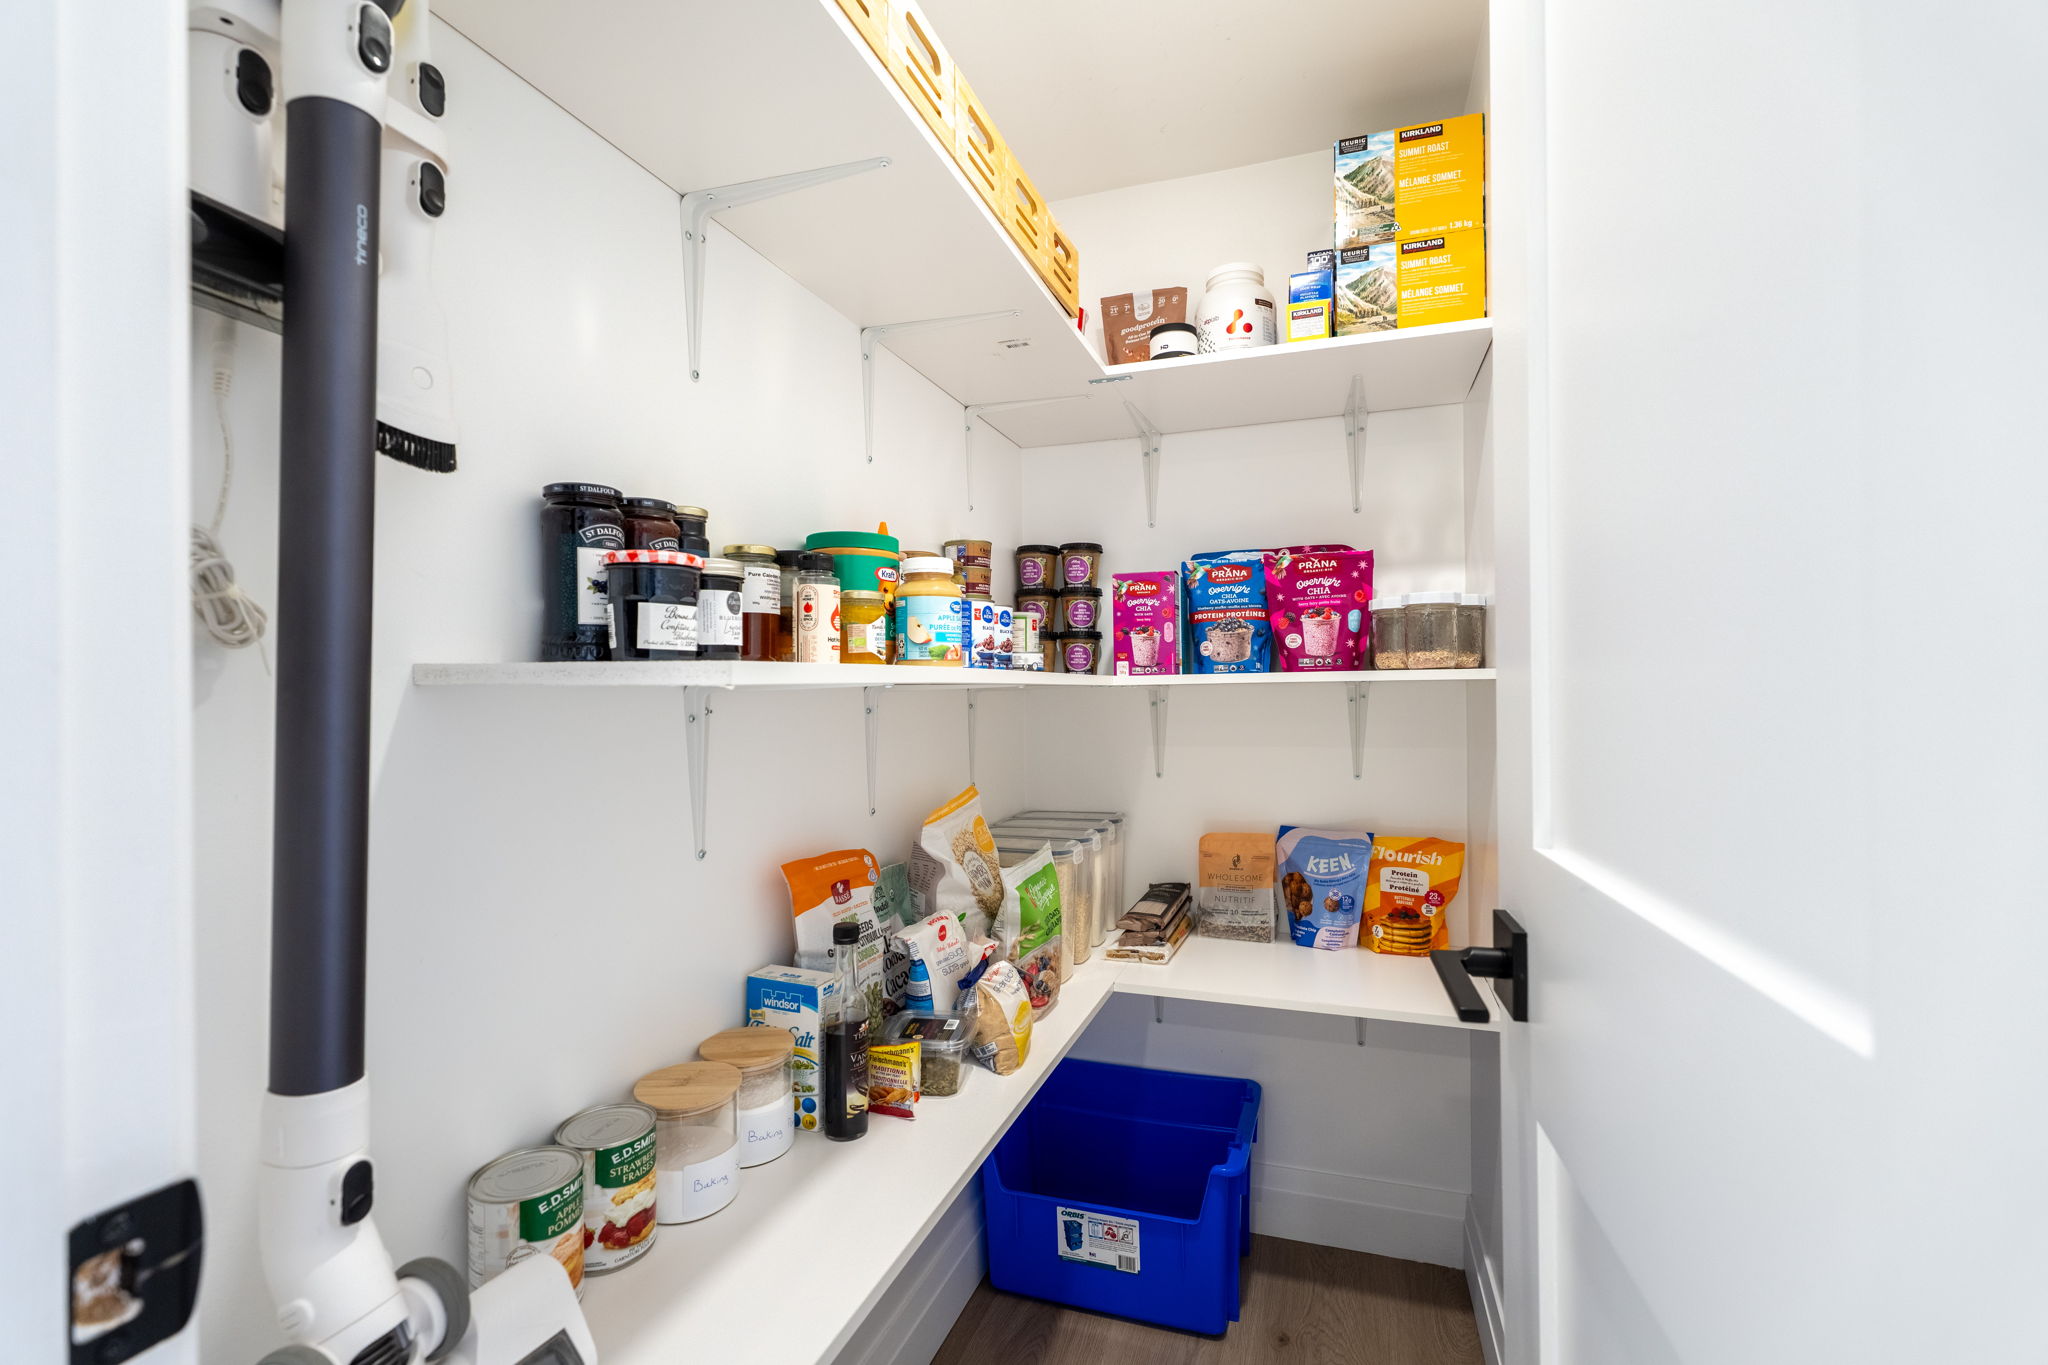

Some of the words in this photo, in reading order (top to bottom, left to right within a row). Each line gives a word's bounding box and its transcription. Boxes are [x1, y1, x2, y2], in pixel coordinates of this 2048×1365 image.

[1401, 125, 1442, 139] KIRKLAND
[1340, 137, 1366, 147] KEURIG
[1399, 144, 1426, 158] SUMMIT
[1427, 141, 1449, 153] ROAST
[1399, 173, 1431, 188] MÉLANGE
[1432, 170, 1462, 183] SOMMET
[1403, 238, 1444, 250] KIRKLAND
[1342, 248, 1368, 257] KEURIG
[1400, 257, 1428, 270] SUMMIT
[1429, 254, 1451, 265] ROAST
[1401, 285, 1433, 299] MÉLANGE
[1434, 283, 1464, 295] SOMMET
[1293, 308, 1322, 317] KIRKLAND
[1120, 316, 1166, 336] goodprotein
[587, 486, 615, 495] DALFOUR
[881, 569, 895, 580] Kraft
[1208, 584, 1251, 595] Overnight
[1296, 576, 1341, 590] Overnight
[1307, 587, 1331, 595] CHIA
[1127, 597, 1160, 607] Overnight
[664, 606, 688, 620] Bonne
[929, 623, 950, 631] PURÉE
[1371, 845, 1443, 866] Flourish
[1207, 872, 1264, 882] WHOLESOME
[1391, 869, 1418, 878] Protein
[1389, 884, 1420, 893] Protéiné
[1214, 895, 1256, 904] NUTRITIF
[859, 919, 874, 934] EEDS
[859, 927, 883, 948] CITROUILL
[763, 996, 799, 1010] windsor
[788, 1026, 816, 1048] Salt
[869, 1054, 908, 1068] Fleischmann's
[870, 1064, 907, 1076] TRADITIONAL
[870, 1074, 908, 1085] TRADITIONNELLE
[747, 1129, 784, 1143] Baking
[622, 1160, 654, 1184] FRAISES
[693, 1174, 729, 1193] Baking
[1060, 1209, 1085, 1220] ORBIS
